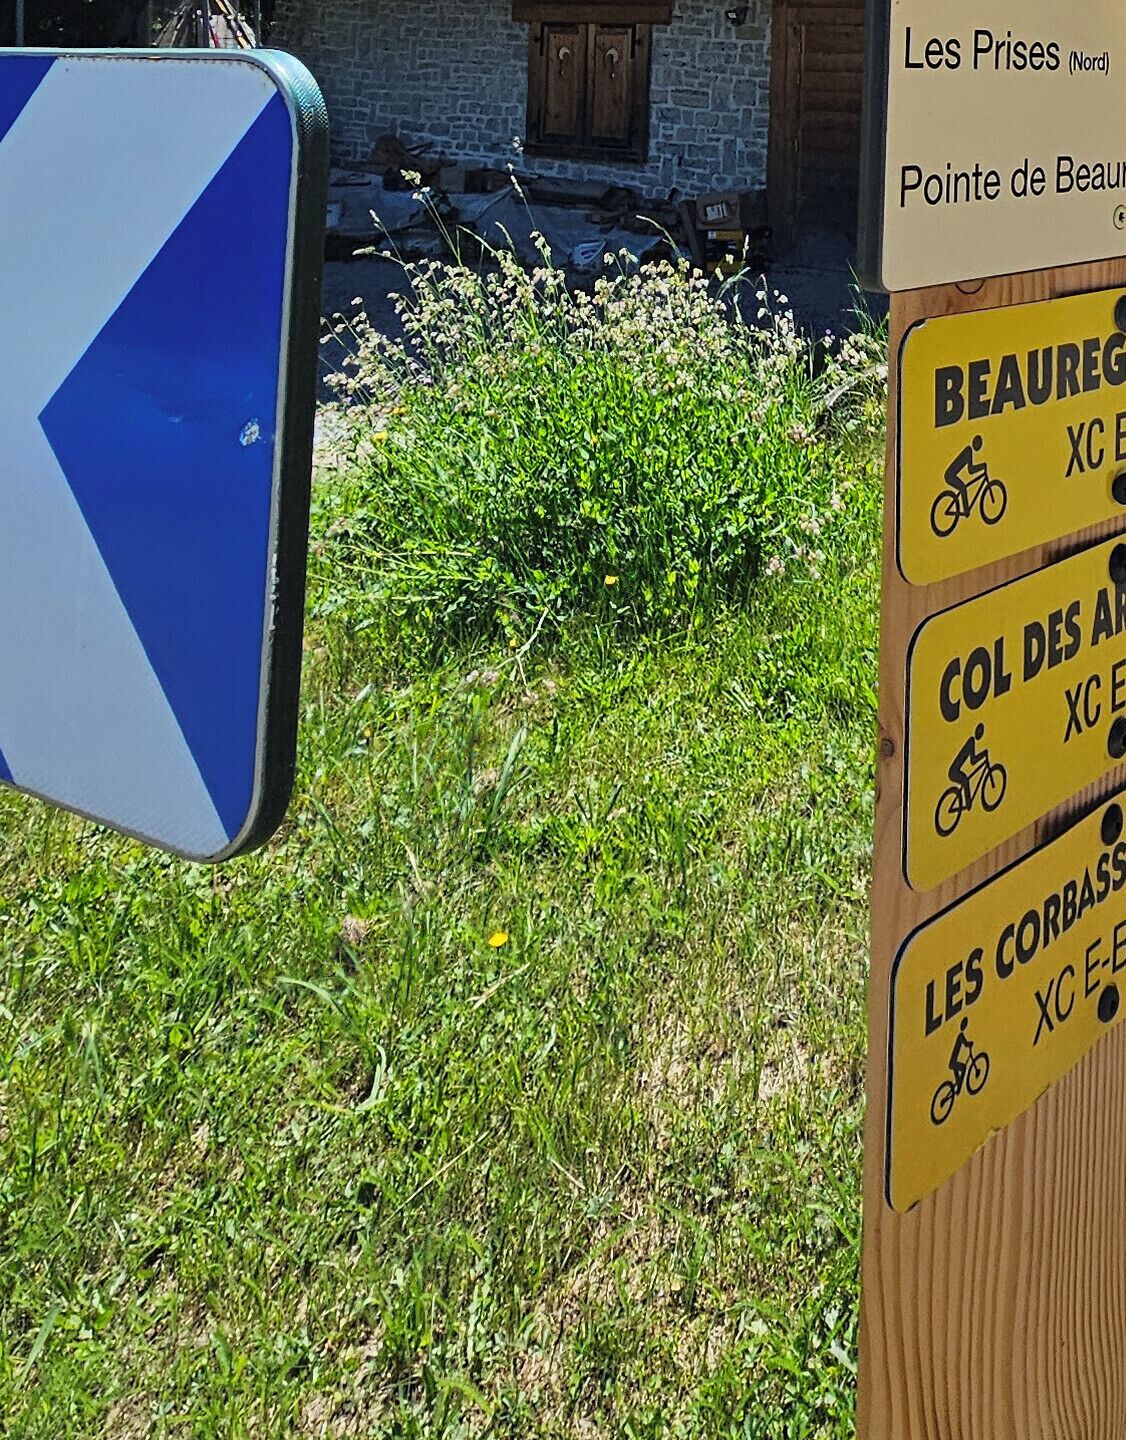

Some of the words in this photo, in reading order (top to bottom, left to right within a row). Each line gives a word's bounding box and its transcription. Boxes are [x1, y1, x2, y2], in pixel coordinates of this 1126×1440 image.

[904, 26, 962, 70] Les
[973, 29, 1061, 71] Prises
[1068, 50, 1110, 76] (Nord)
[900, 162, 1001, 208] Pointe
[1010, 158, 1047, 198] de
[1065, 419, 1105, 478] XC
[938, 636, 1012, 723] COL
[1022, 599, 1082, 683] DES
[1062, 673, 1102, 744] XC
[923, 946, 985, 1038] LES
[1032, 964, 1076, 1047] XC
